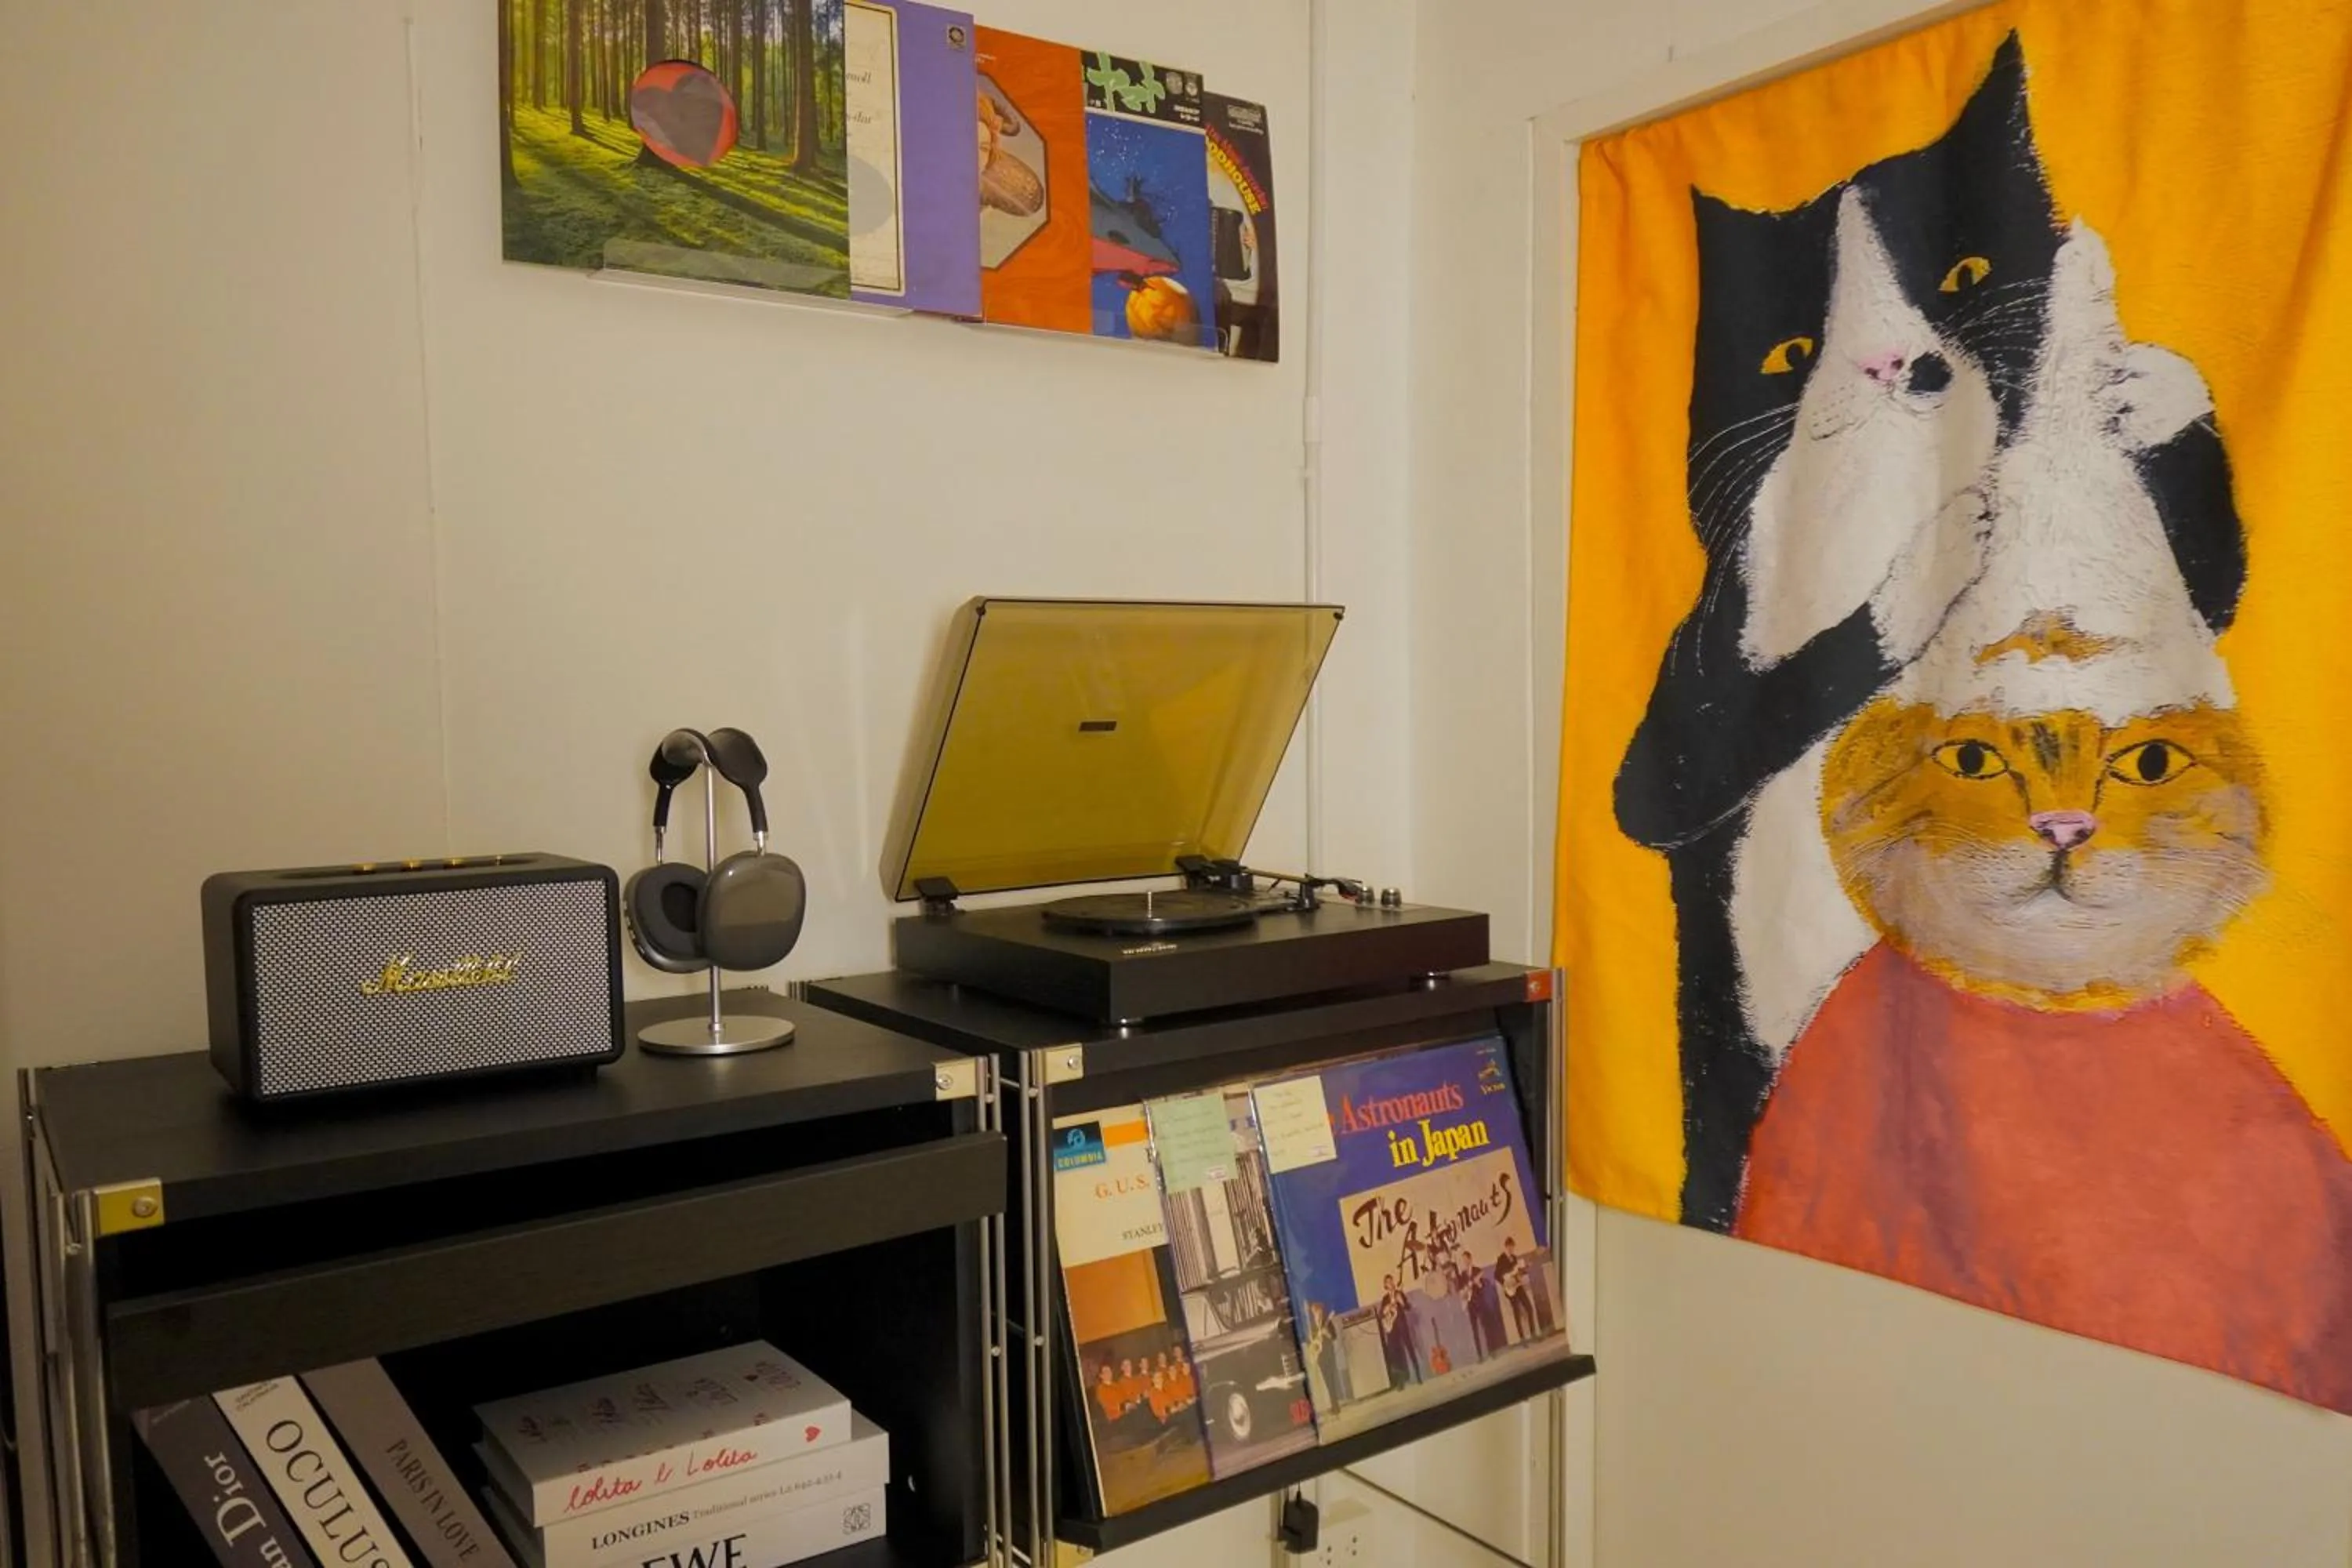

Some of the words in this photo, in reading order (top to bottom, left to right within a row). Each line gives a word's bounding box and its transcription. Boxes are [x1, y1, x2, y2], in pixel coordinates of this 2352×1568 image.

[1341, 1080, 1465, 1134] Astronauts
[1387, 1129, 1420, 1167] in
[1417, 1117, 1490, 1167] Japan
[1352, 1196, 1412, 1249] The
[204, 1452, 267, 1548] Dior
[386, 1438, 433, 1494] PARIS
[436, 1510, 481, 1562] LOVE
[592, 1511, 690, 1550] LONGINES
